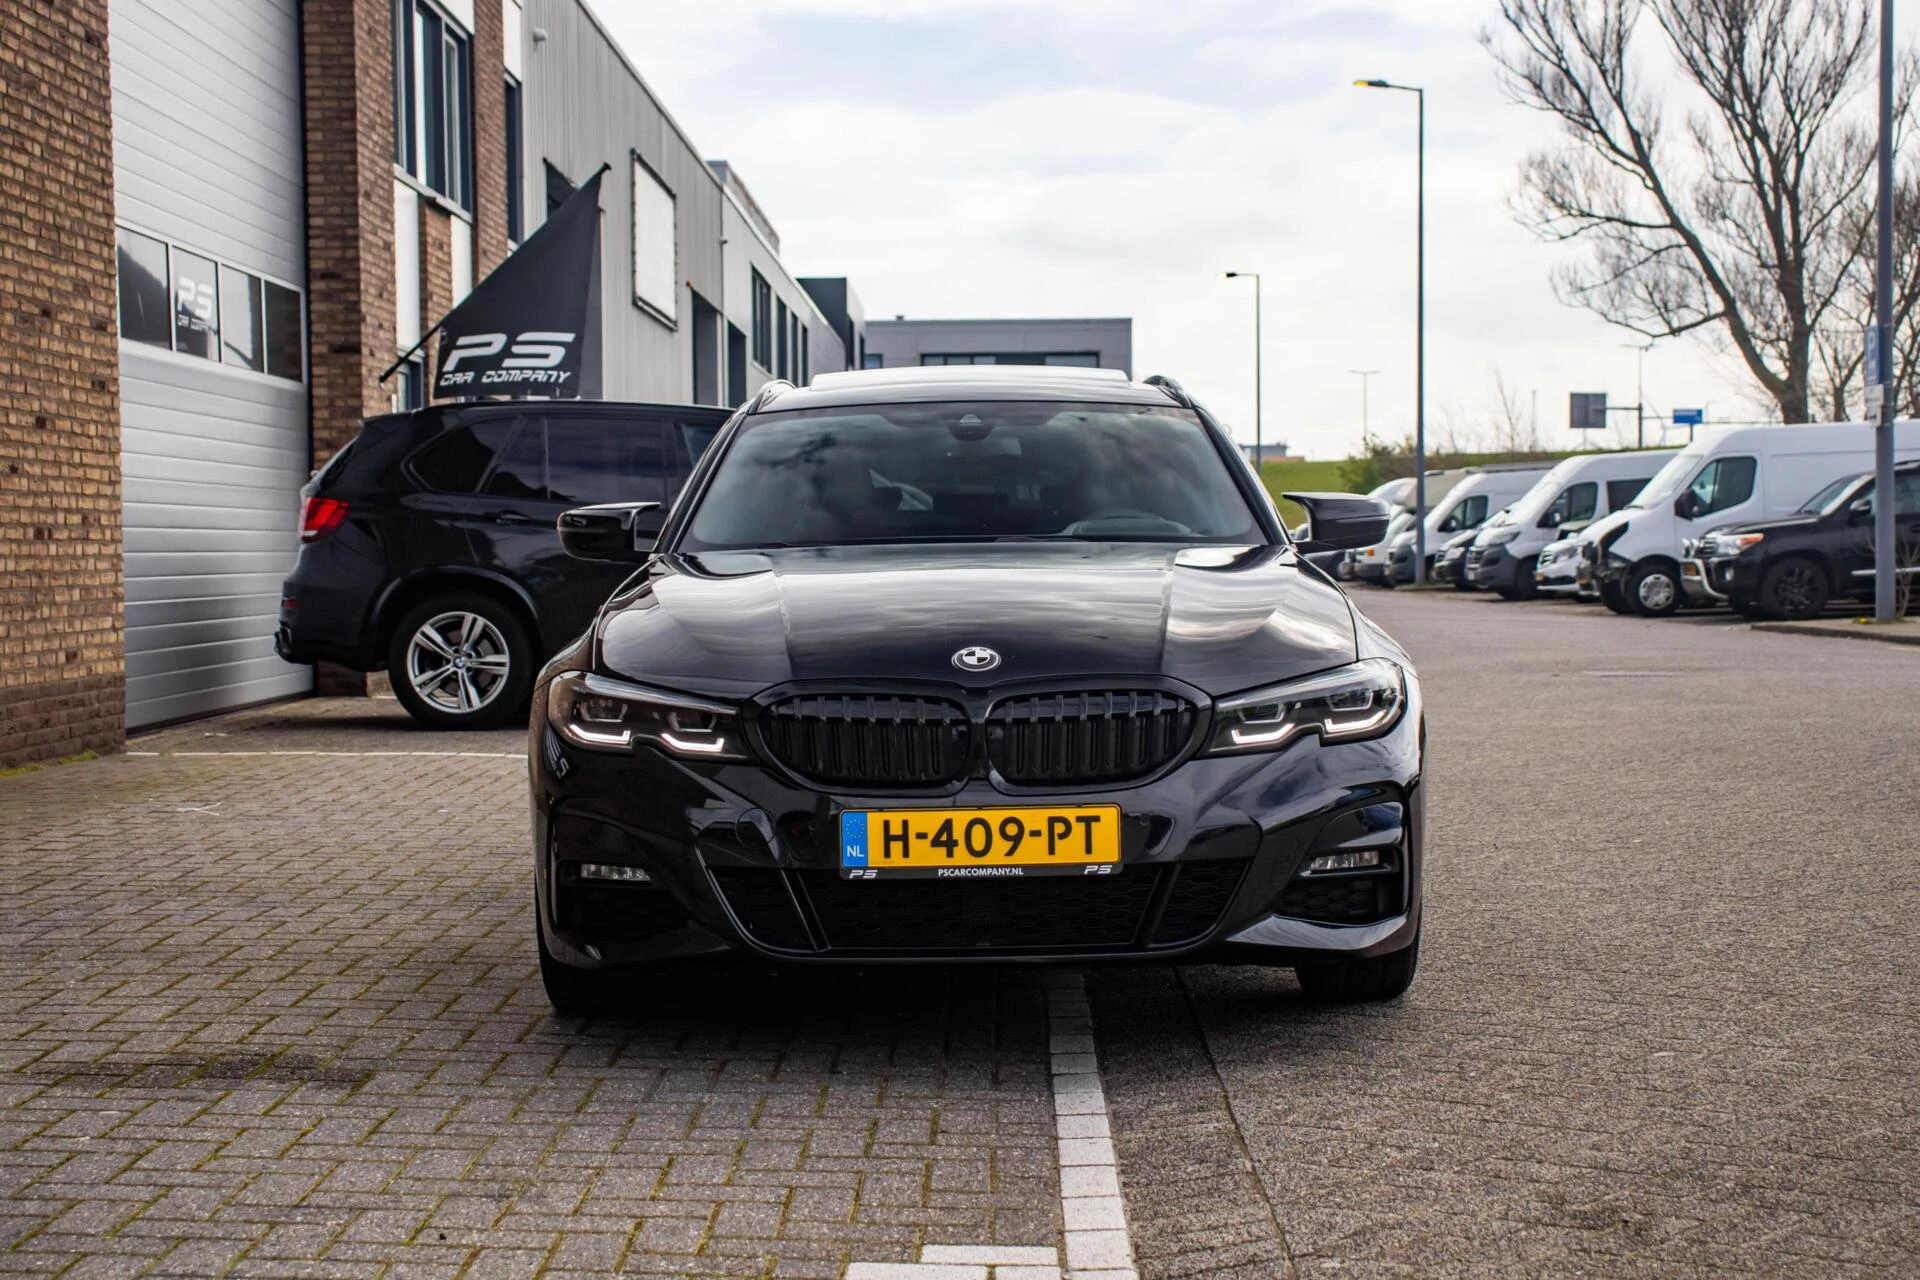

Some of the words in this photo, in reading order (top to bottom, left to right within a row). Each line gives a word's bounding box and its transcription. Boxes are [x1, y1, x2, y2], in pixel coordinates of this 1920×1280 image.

[177, 276, 212, 320] PS
[442, 331, 576, 372] PS
[439, 371, 475, 386] CAR
[481, 369, 573, 384] COMPANY
[882, 815, 1102, 859] H-409-PT
[846, 845, 864, 858] NL
[849, 869, 878, 879] PS
[937, 867, 1024, 877] PSCARCOMPANY.NL
[1083, 864, 1113, 874] PS
